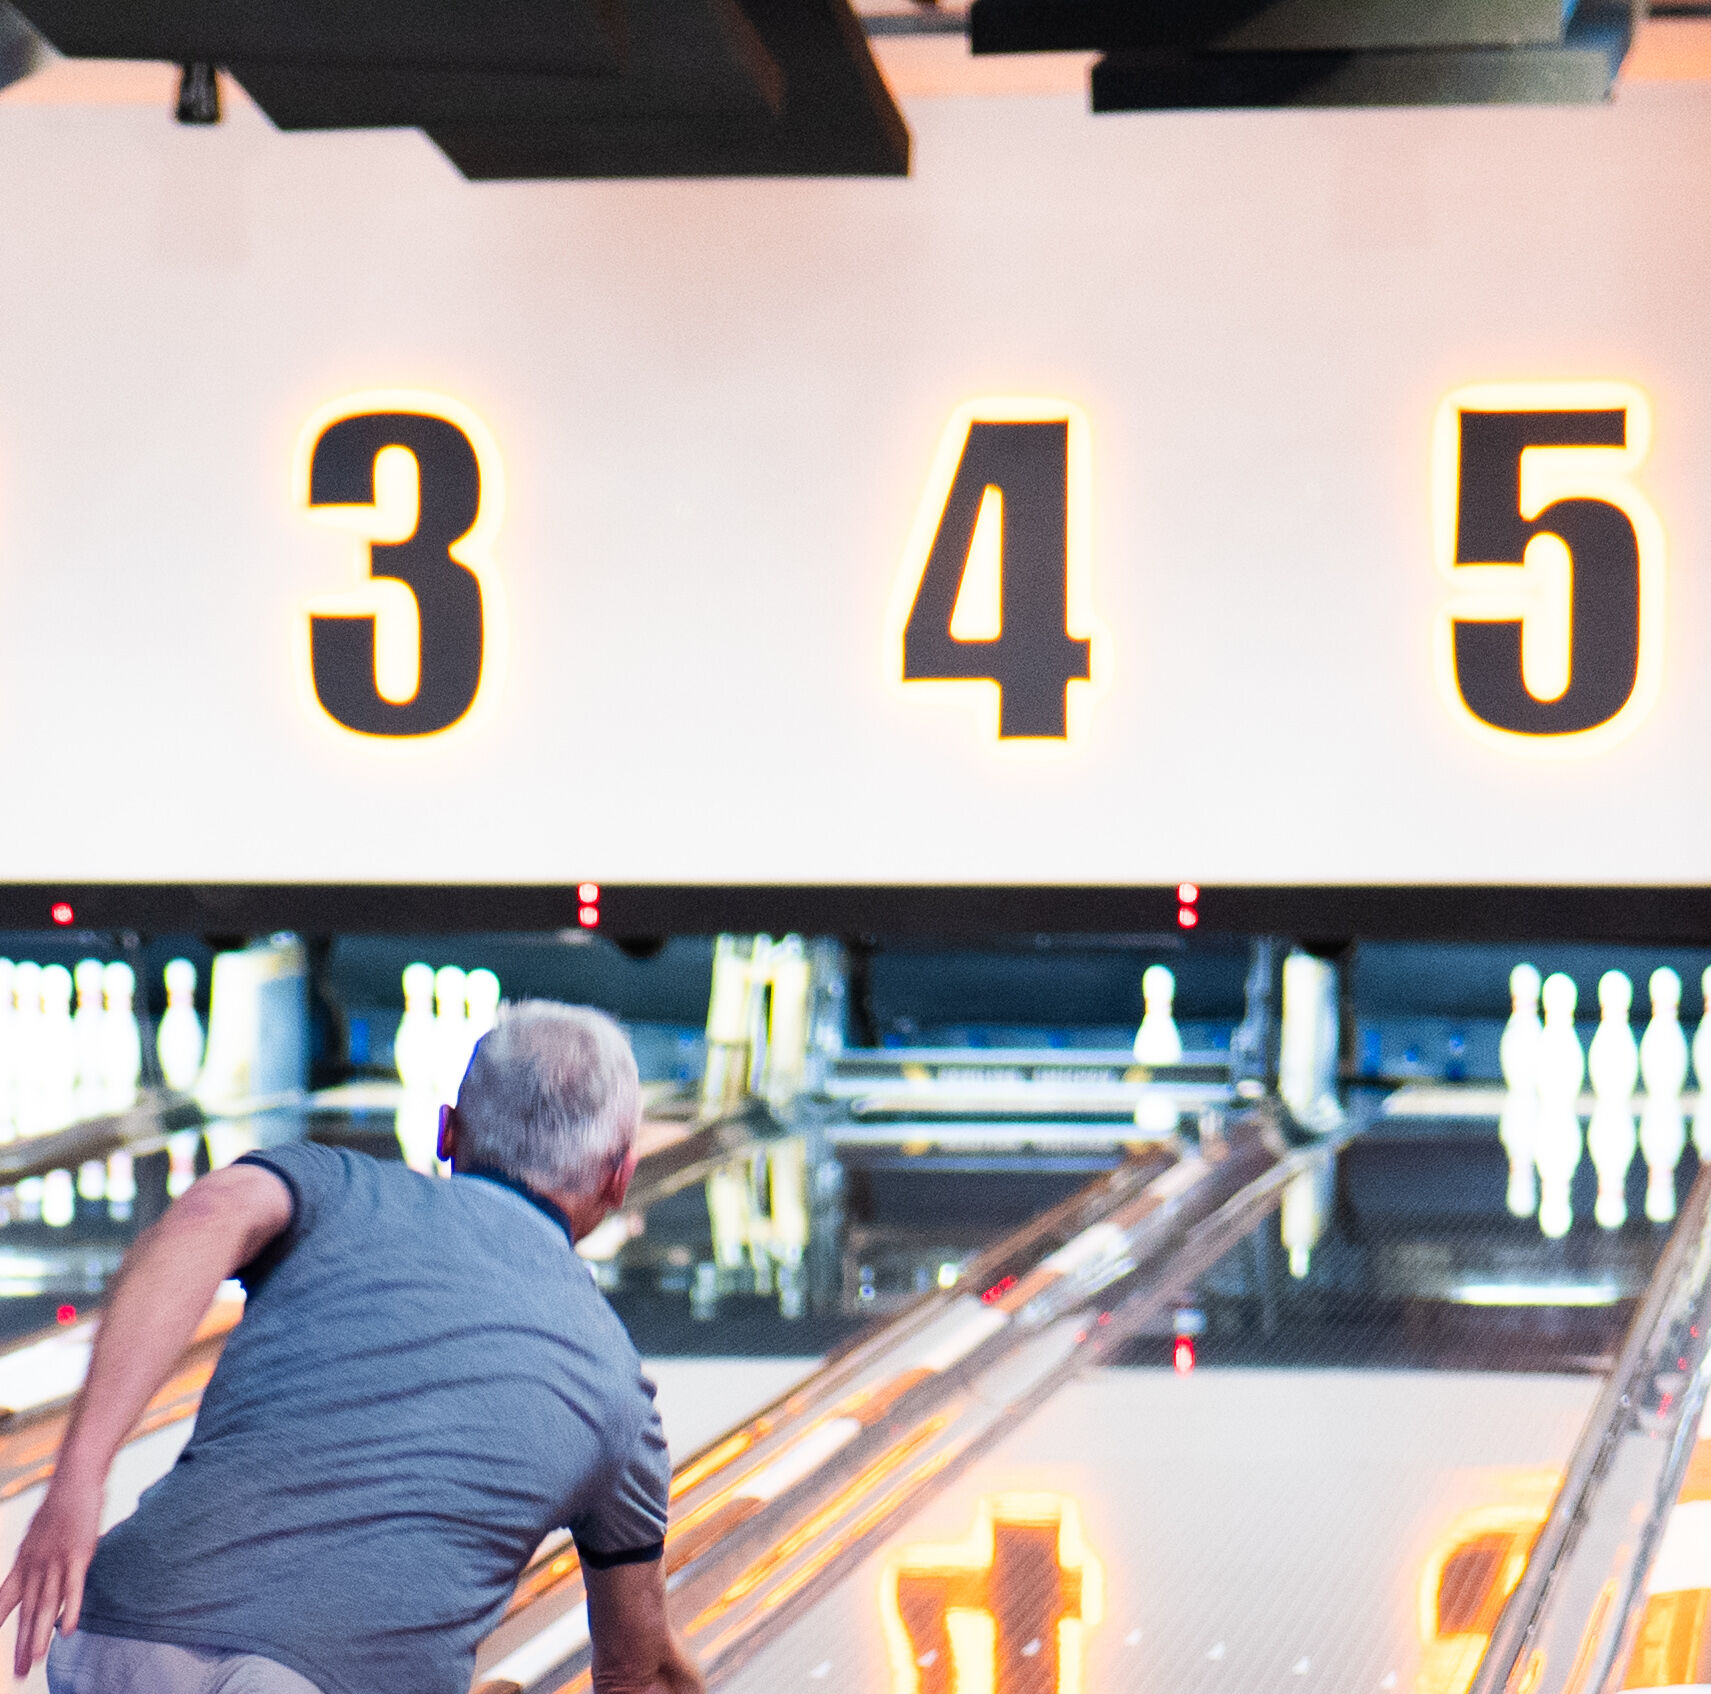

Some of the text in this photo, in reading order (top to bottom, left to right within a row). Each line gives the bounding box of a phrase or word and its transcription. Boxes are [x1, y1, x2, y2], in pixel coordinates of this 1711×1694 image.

[307, 411, 486, 738] 3
[901, 420, 1091, 739] 4
[1451, 408, 1641, 736] 5
